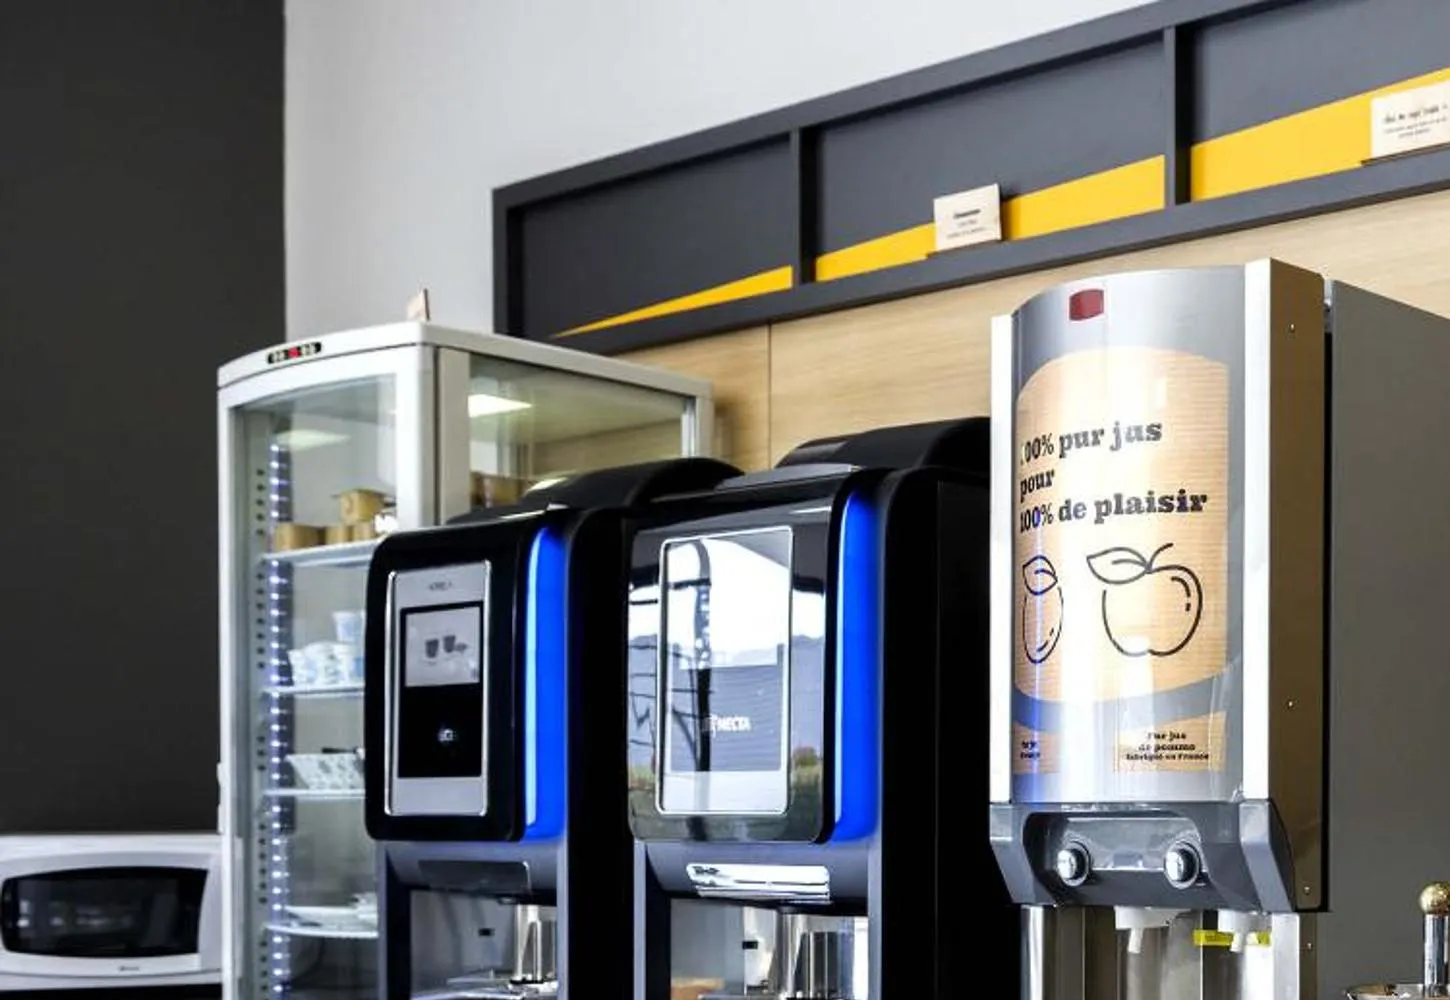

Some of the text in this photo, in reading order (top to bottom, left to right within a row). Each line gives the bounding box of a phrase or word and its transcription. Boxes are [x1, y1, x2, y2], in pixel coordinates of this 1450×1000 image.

[1058, 427, 1105, 459] pur
[1110, 421, 1163, 451] jus
[1020, 469, 1056, 503] pour
[1020, 489, 1208, 534] 100% de plaisir
